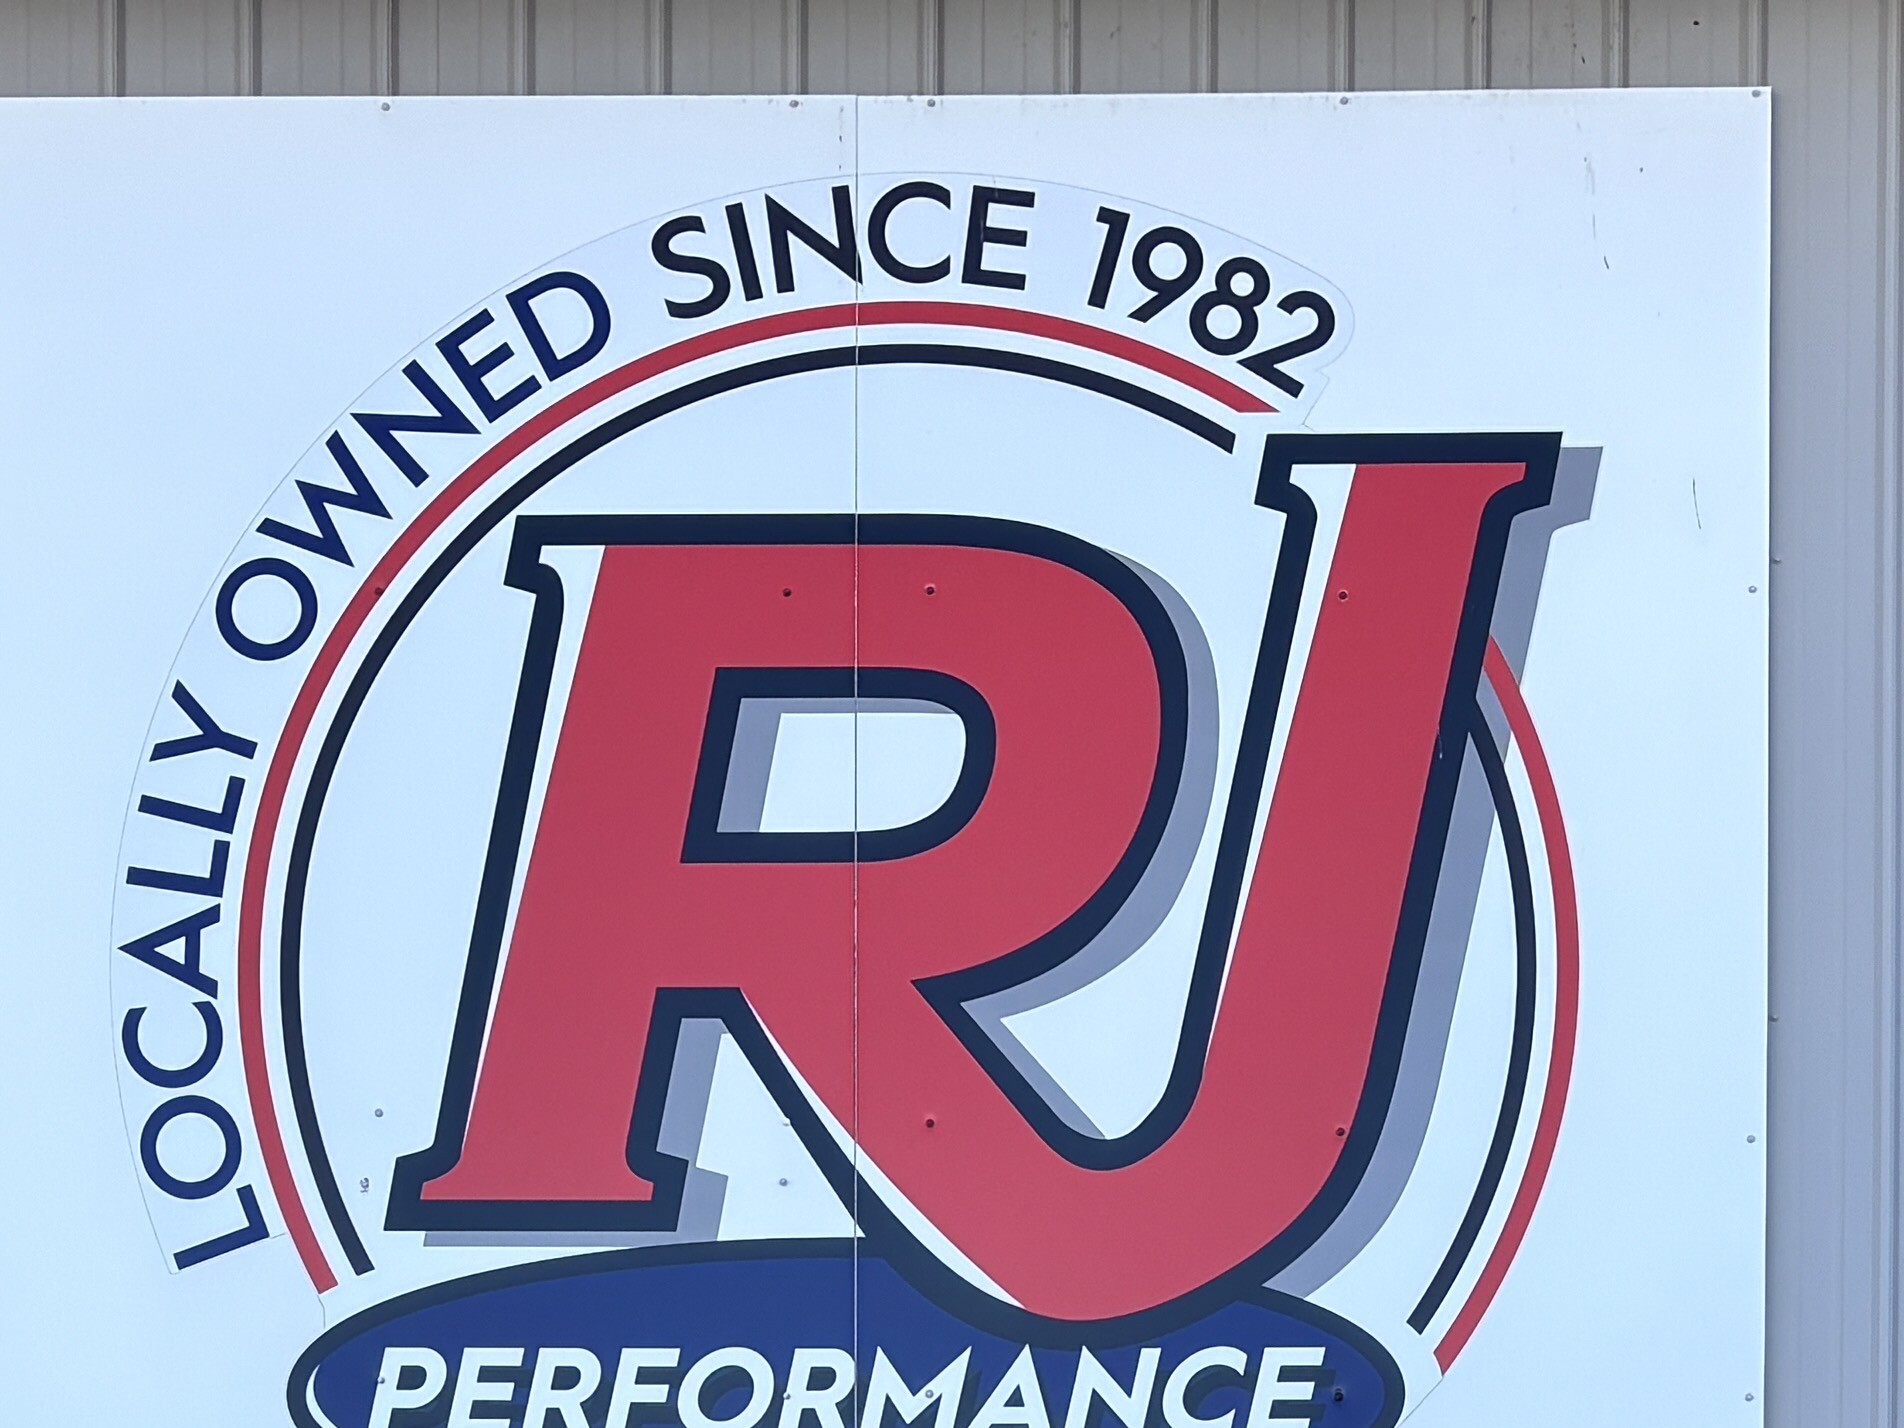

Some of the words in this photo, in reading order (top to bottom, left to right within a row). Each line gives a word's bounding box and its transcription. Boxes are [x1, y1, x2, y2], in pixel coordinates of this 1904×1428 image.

[119, 682, 270, 1270] LOCALLY
[216, 270, 612, 658] OWNED
[650, 181, 1036, 320] SINCE
[1086, 204, 1336, 397] 1982
[384, 432, 1568, 1342] RJ
